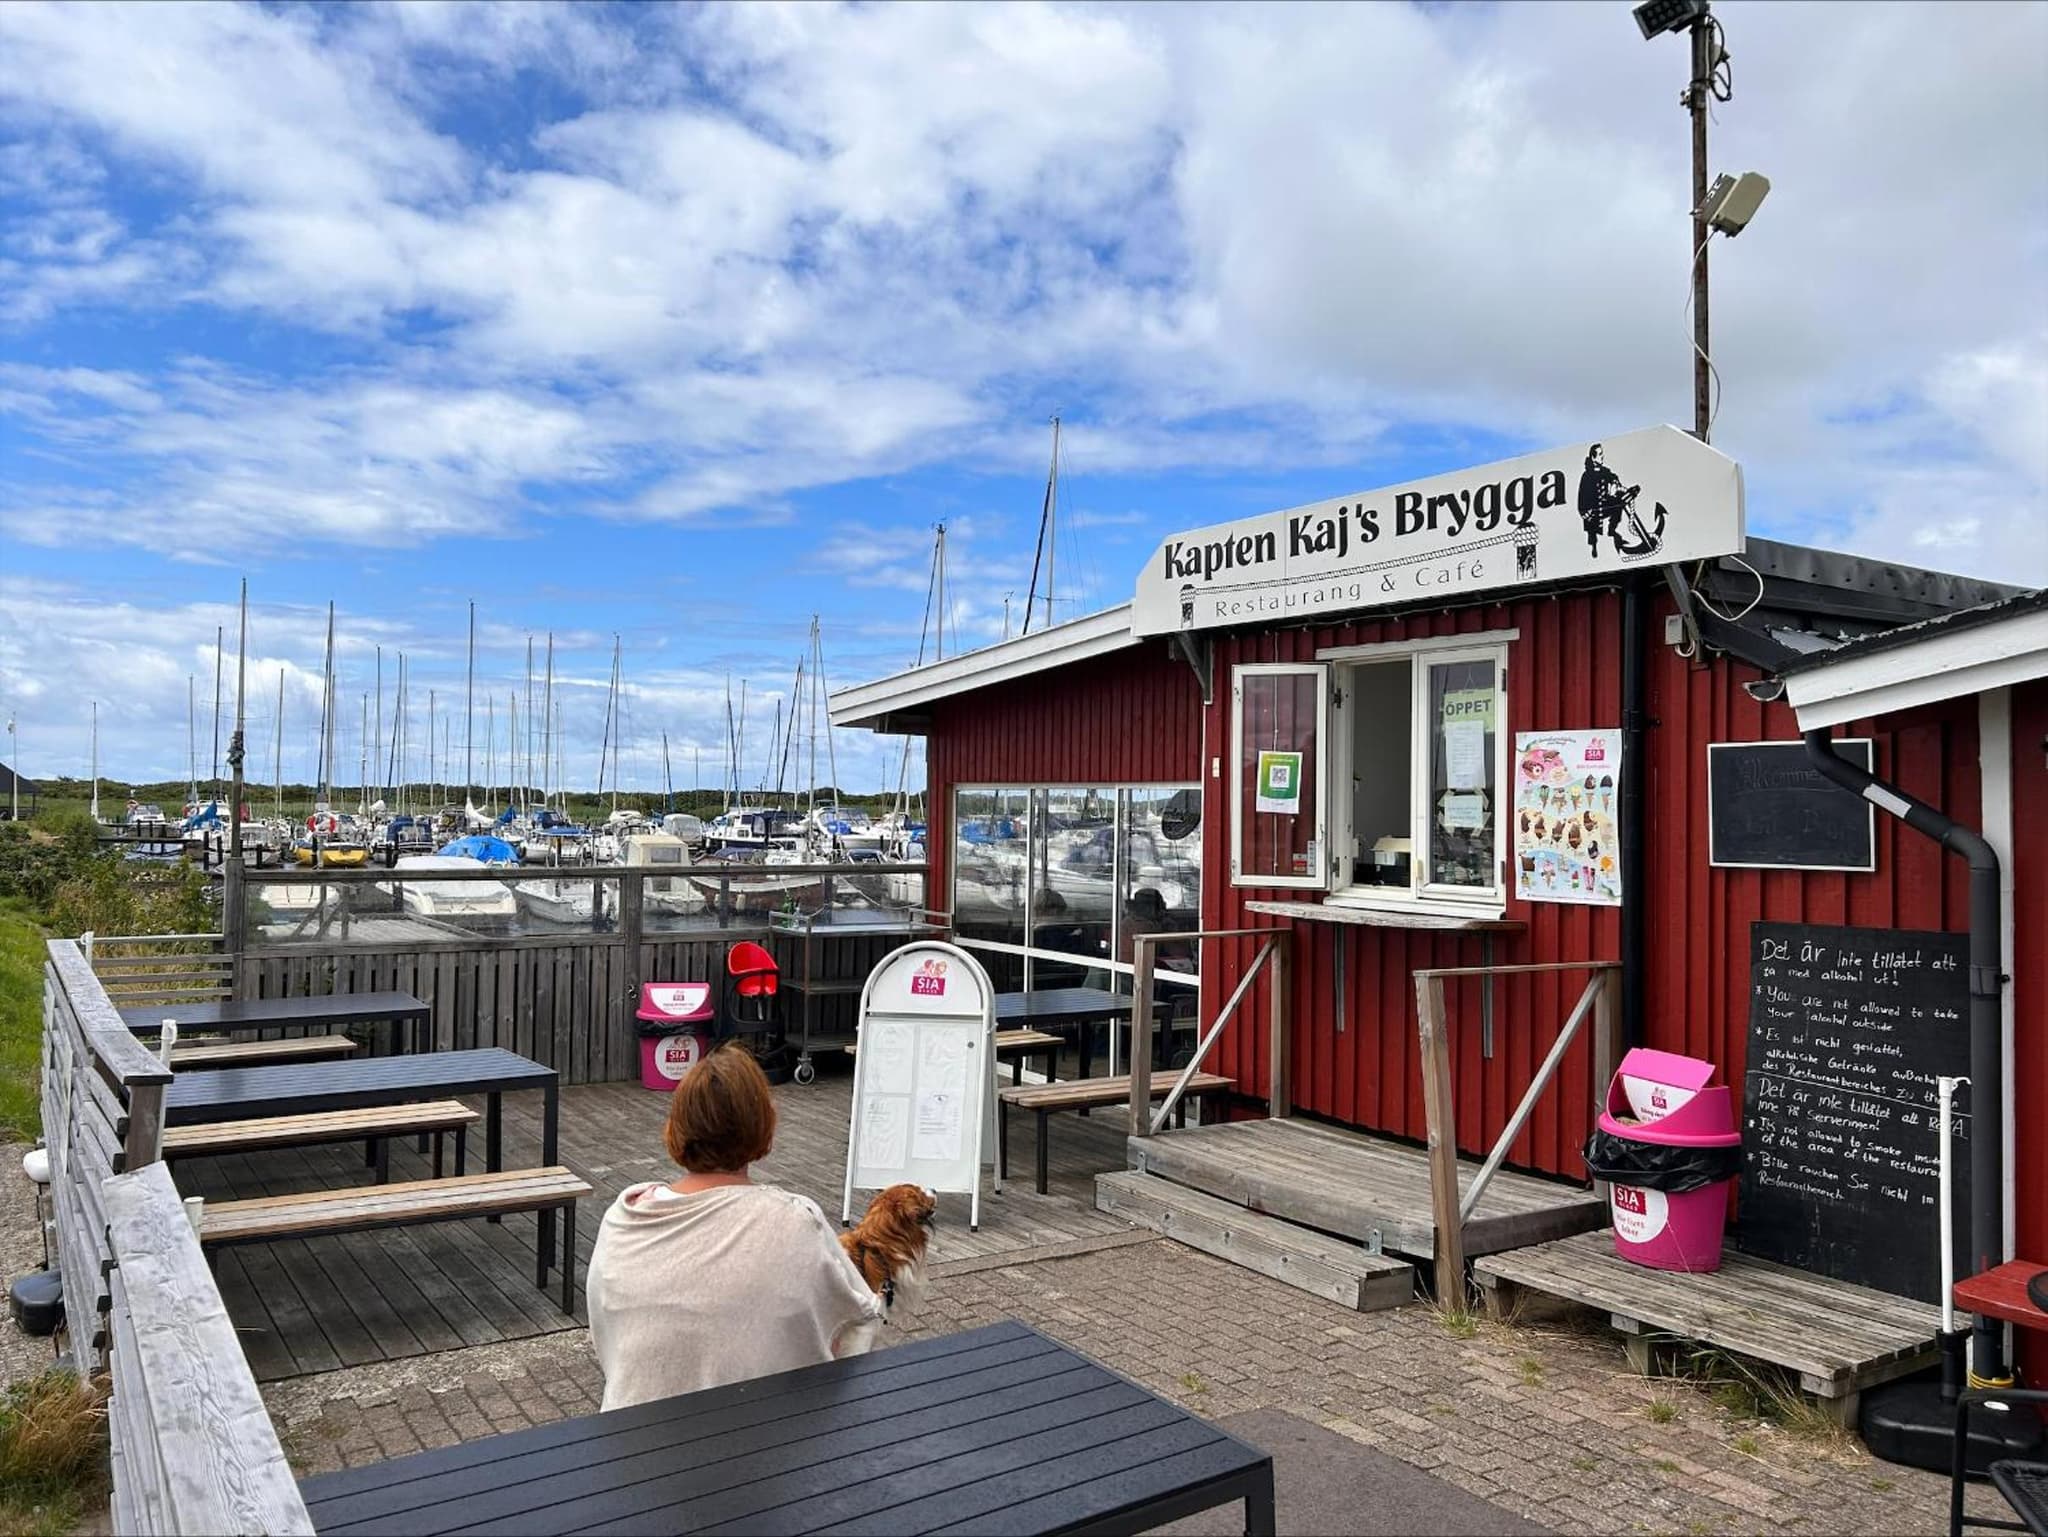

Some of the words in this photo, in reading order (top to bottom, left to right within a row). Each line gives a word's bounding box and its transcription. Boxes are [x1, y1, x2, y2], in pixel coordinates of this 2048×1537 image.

[1165, 529, 1277, 582] Kapten
[1289, 502, 1380, 558] Kaj's
[1395, 469, 1567, 537] Brygga
[1215, 581, 1362, 617] Restaurang
[1382, 573, 1398, 590] &
[1416, 559, 1485, 587] Café
[1445, 699, 1492, 716] ÖPPET
[1761, 938, 1791, 961] Det
[1800, 940, 1827, 963] är
[1872, 950, 1923, 969] tillåtet
[1932, 953, 1958, 972] att
[918, 977, 939, 990] SIA
[1766, 985, 1792, 1003] You
[1801, 996, 1824, 1008] are
[1833, 999, 1848, 1010] not
[1860, 1001, 1901, 1017] allowed
[1911, 1006, 1924, 1018] to
[1934, 1008, 1960, 1020] take
[668, 1050, 687, 1060] SIA
[1761, 1060, 1780, 1071] des
[1758, 1077, 1787, 1099] Det
[1792, 1088, 1813, 1104] är
[1901, 1112, 1920, 1126] att
[1780, 1136, 1799, 1150] the
[1807, 1143, 1835, 1155] area
[1843, 1148, 1858, 1160] of
[1862, 1152, 1880, 1164] the
[1850, 1135, 1861, 1149] to
[1759, 1151, 1789, 1170] Bitte
[1847, 1172, 1871, 1190] Sie
[1880, 1186, 1909, 1202] nicht
[1617, 1187, 1640, 1207] SIA
